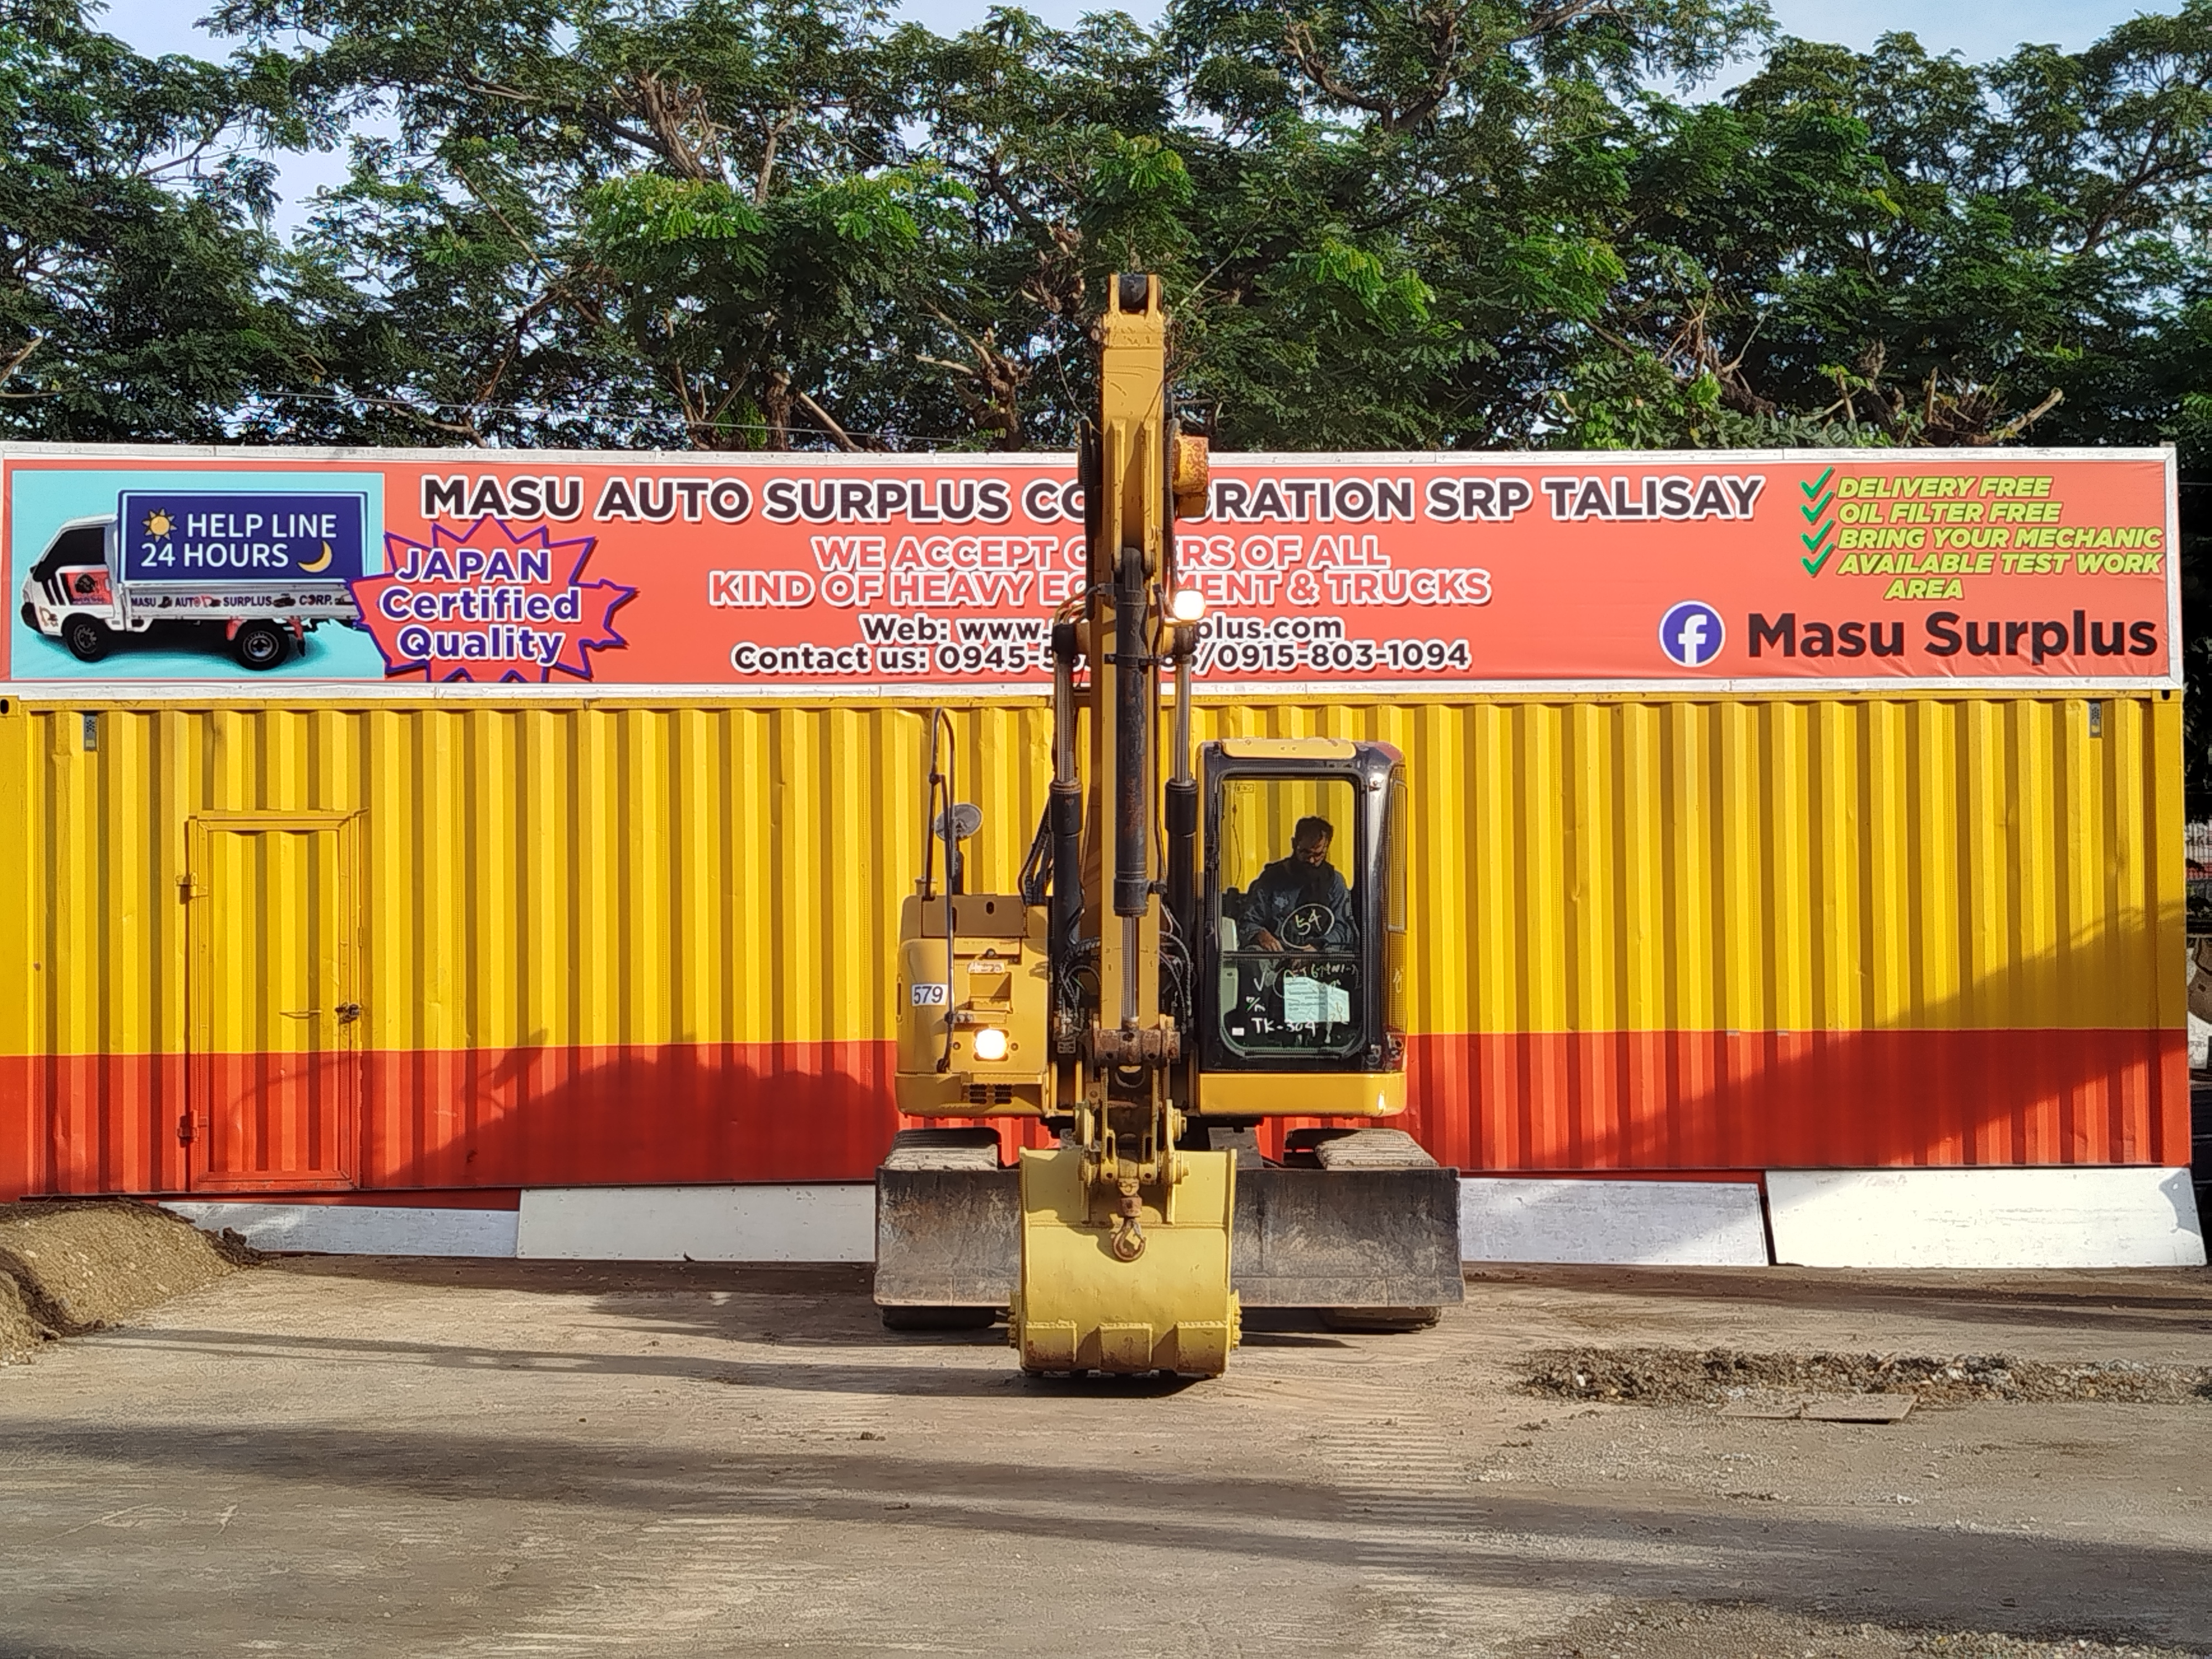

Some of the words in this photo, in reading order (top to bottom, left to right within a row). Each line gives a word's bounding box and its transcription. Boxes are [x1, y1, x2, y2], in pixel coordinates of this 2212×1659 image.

[425, 479, 580, 517] MASU
[597, 481, 749, 518] AUTO
[766, 482, 1008, 519] SURPLUS
[1026, 481, 1411, 519] CORATION
[1428, 481, 1529, 518] SRP
[1546, 478, 1759, 517] TALISAY
[1838, 477, 1971, 497] DELIVERY
[1979, 477, 2053, 497] FREE
[1839, 503, 1883, 523] OIL
[1889, 503, 1984, 523] FILTER
[1989, 502, 2063, 522] FREE
[187, 513, 263, 538] HELP
[272, 514, 337, 538] LINE
[1839, 529, 1926, 549] BRING
[1934, 528, 2010, 548] YOUR
[2015, 528, 2163, 548] MECHANIC
[140, 542, 176, 567] 24
[184, 542, 289, 568] HOURS
[397, 549, 550, 582] JAPAN
[815, 540, 883, 568] WE
[894, 539, 1055, 568] ACCEPT
[1067, 539, 1232, 567] ORS
[1244, 538, 1300, 567] OF
[1312, 538, 1388, 567] ALL
[1837, 554, 1994, 574] AVAILABLE
[2001, 554, 2072, 573] TEST
[2076, 554, 2164, 573] WORK
[712, 574, 812, 603] KIND
[824, 574, 881, 603] OF
[893, 574, 1032, 603] HEAVY
[1290, 572, 1318, 602] &
[1326, 572, 1489, 602] TRUCKS
[1884, 579, 1964, 599] AREA
[131, 597, 156, 607] MASU
[223, 595, 273, 607] SURPLUS
[382, 587, 580, 620] Certified
[863, 616, 948, 641] Web:
[1747, 612, 1905, 658] Masu
[1924, 609, 2159, 665] Surplus
[399, 626, 564, 665] Quality
[734, 645, 868, 670] Contact
[879, 648, 927, 670] us:
[913, 985, 943, 1004] 579
